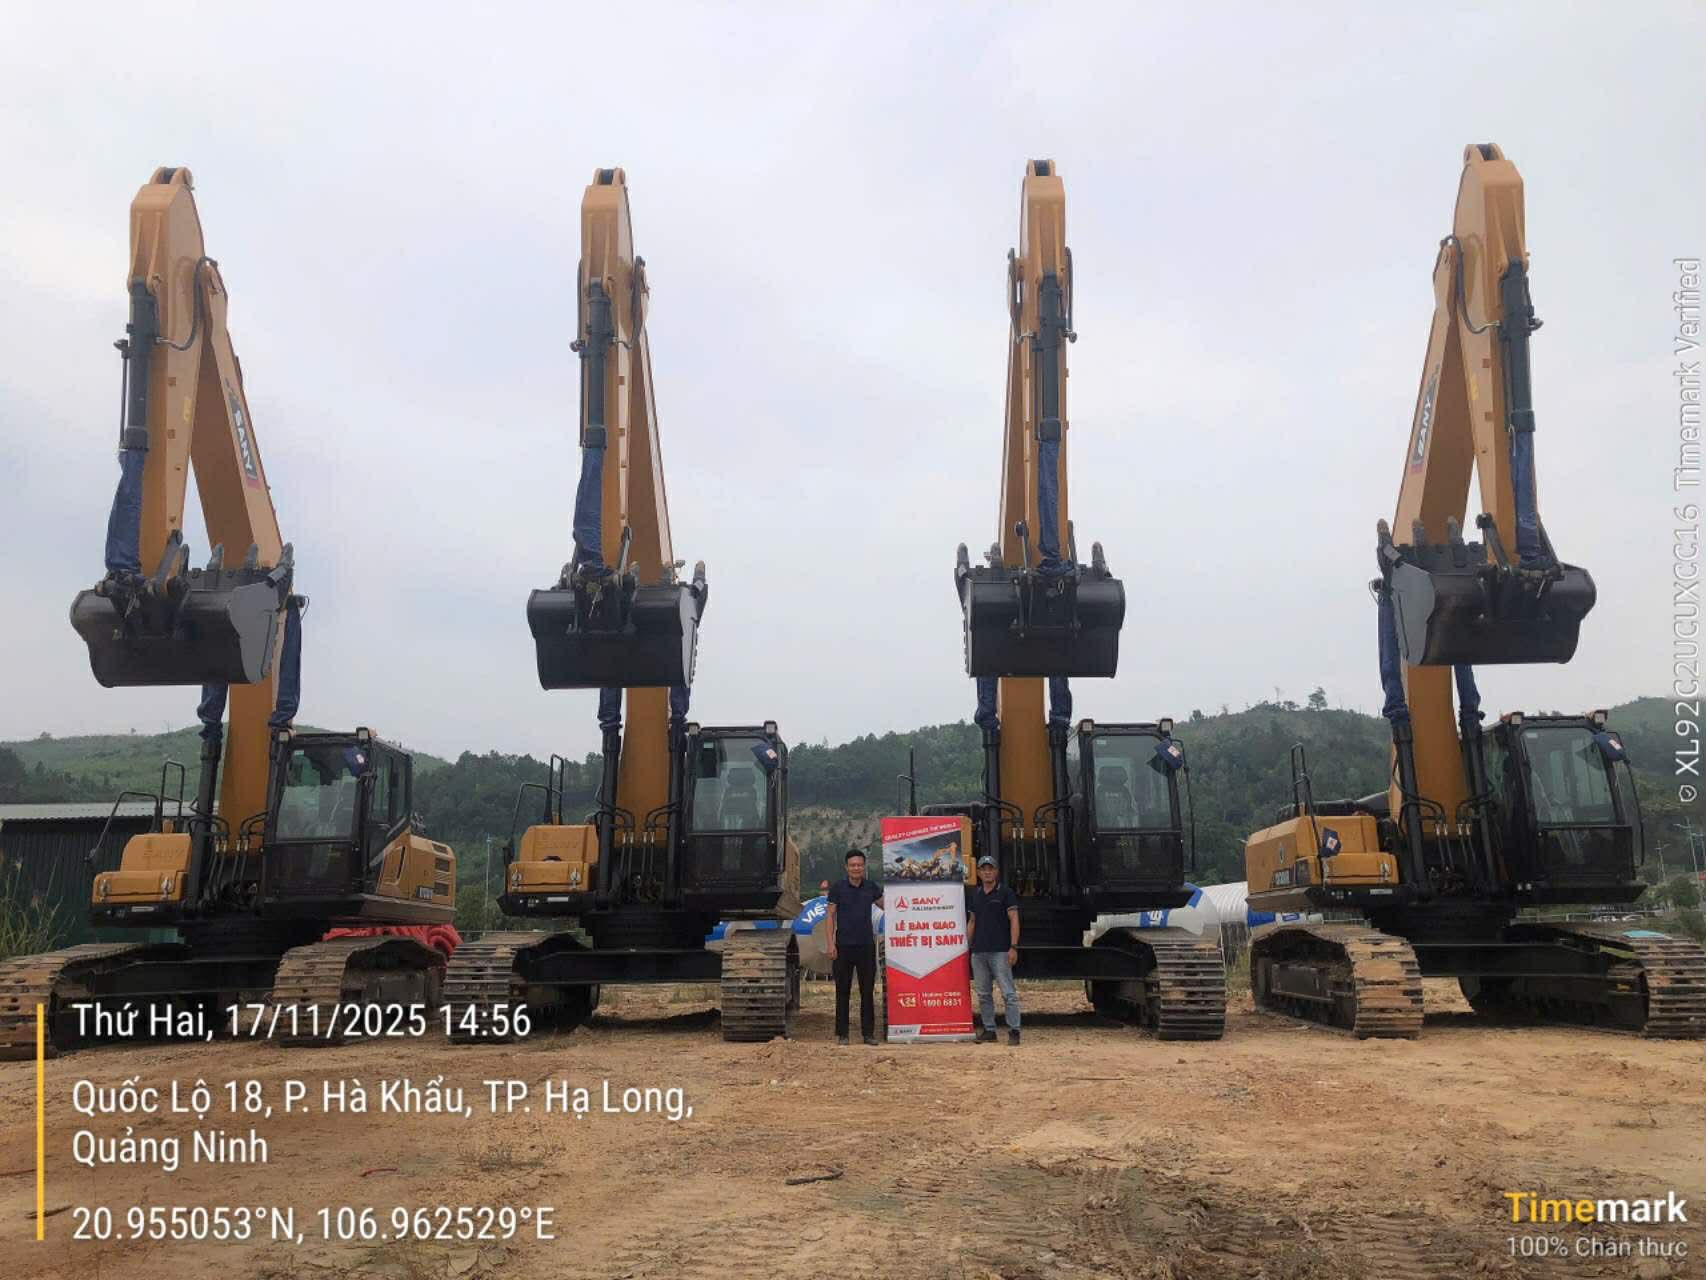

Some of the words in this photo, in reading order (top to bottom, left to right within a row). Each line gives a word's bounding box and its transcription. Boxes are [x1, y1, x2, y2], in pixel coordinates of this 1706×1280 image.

[234, 408, 253, 471] SANY
[912, 897, 941, 905] SANY
[932, 921, 957, 930] GIAO
[920, 935, 933, 949] BỊ
[935, 934, 964, 946] SANY
